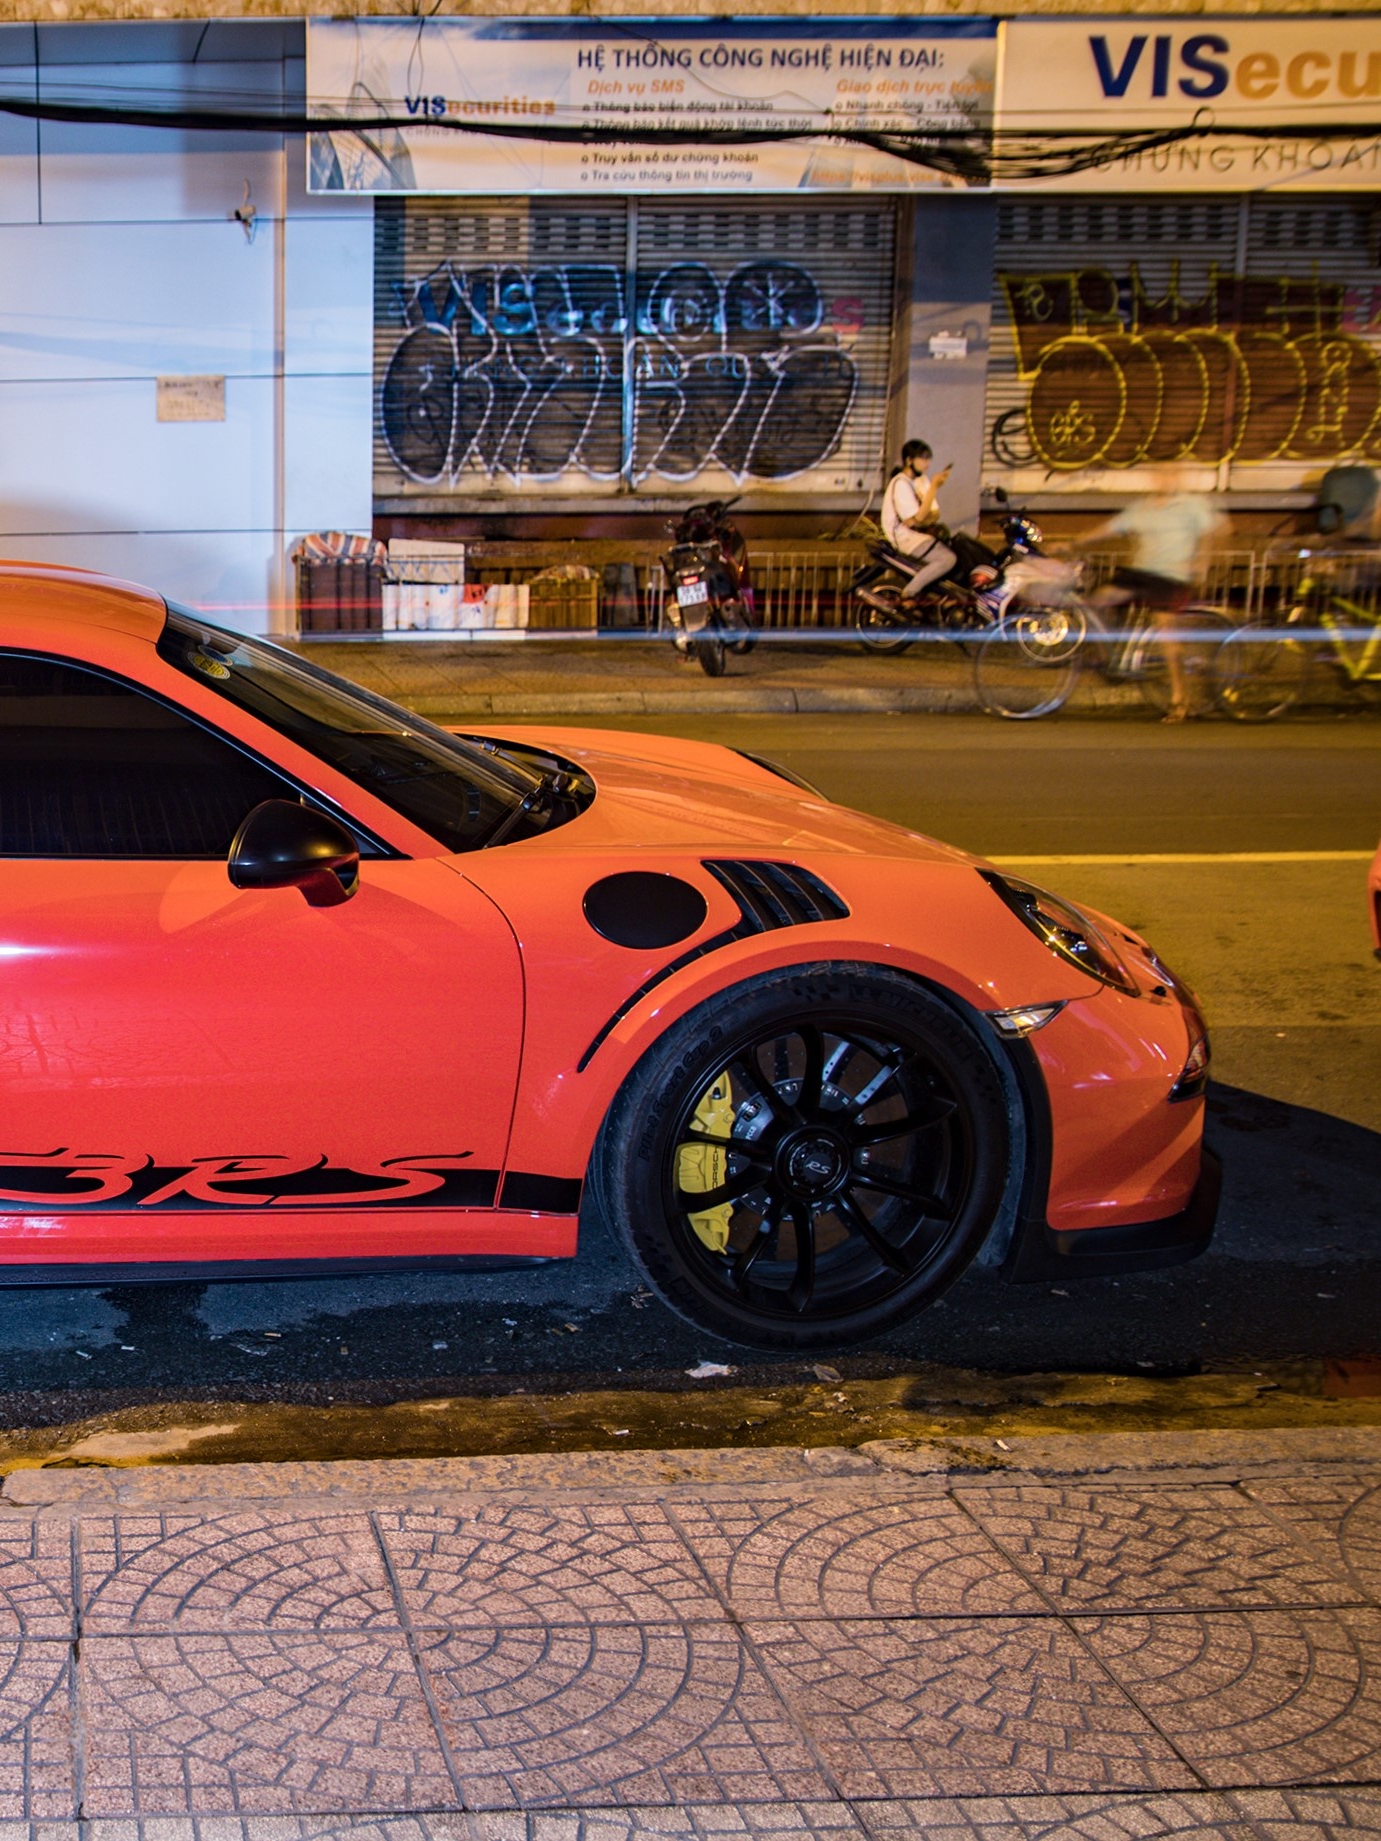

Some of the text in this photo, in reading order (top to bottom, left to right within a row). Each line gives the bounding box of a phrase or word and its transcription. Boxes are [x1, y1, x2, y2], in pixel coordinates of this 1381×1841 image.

[577, 44, 606, 72] HỆ
[699, 41, 764, 68] CÔNG
[771, 42, 832, 72] NGHỆ
[840, 42, 892, 71] HIỆN
[587, 79, 685, 96] Dịch vụ SMS
[836, 78, 872, 94] Giao
[876, 79, 909, 95] dịch
[405, 95, 556, 116] VISecurities
[592, 153, 618, 166] Truy
[592, 170, 610, 181] Tra
[805, 1160, 832, 1174] RS
